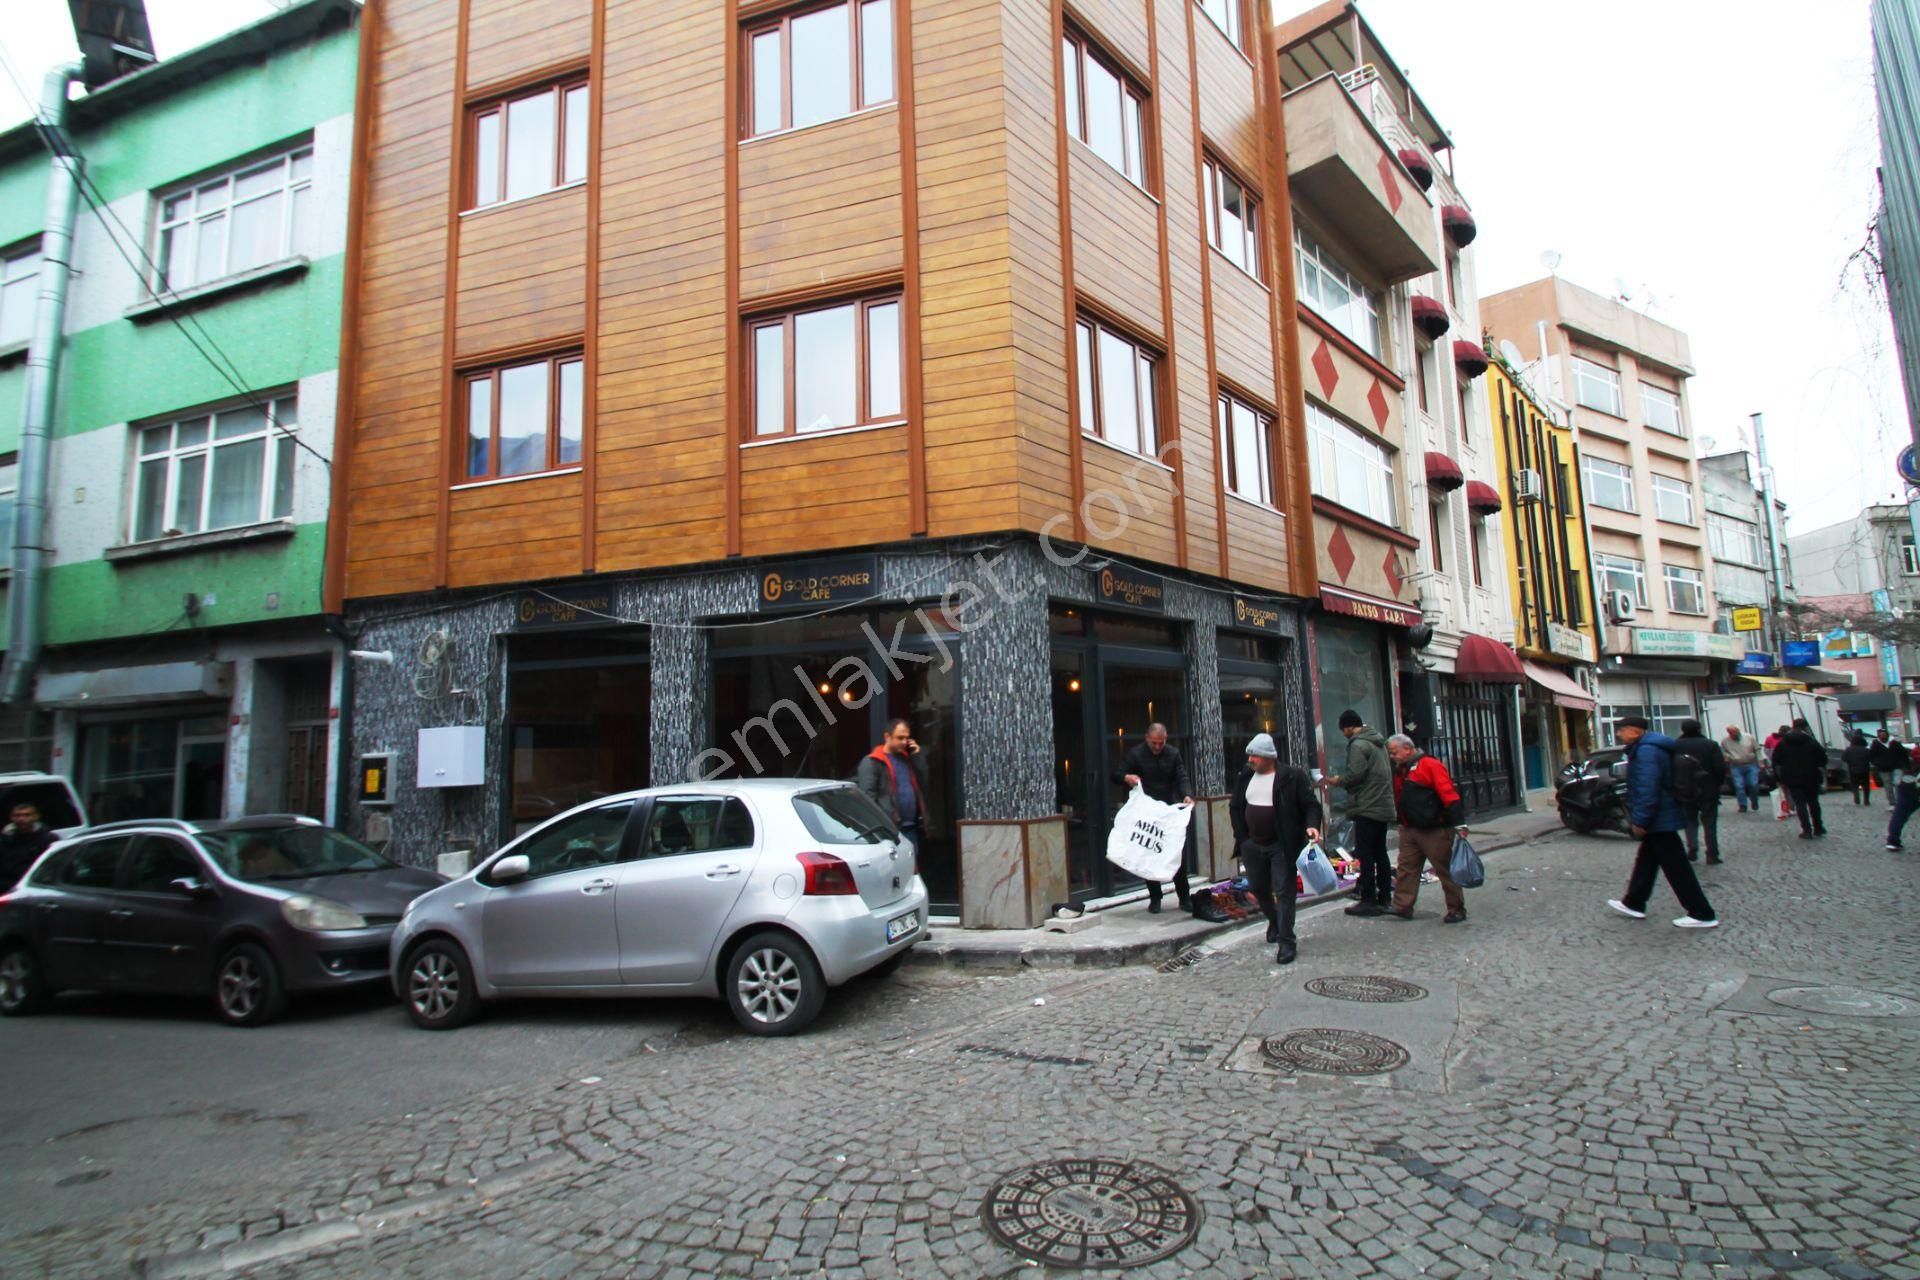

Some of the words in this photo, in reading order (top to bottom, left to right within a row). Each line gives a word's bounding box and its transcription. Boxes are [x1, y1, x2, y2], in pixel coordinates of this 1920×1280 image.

[784, 579, 817, 592] GOLD
[820, 573, 870, 588] CORNER
[1135, 584, 1161, 598] CORNER
[801, 588, 831, 600] CAFE
[1352, 601, 1378, 618] PATSO
[1130, 832, 1163, 853] PLUS
